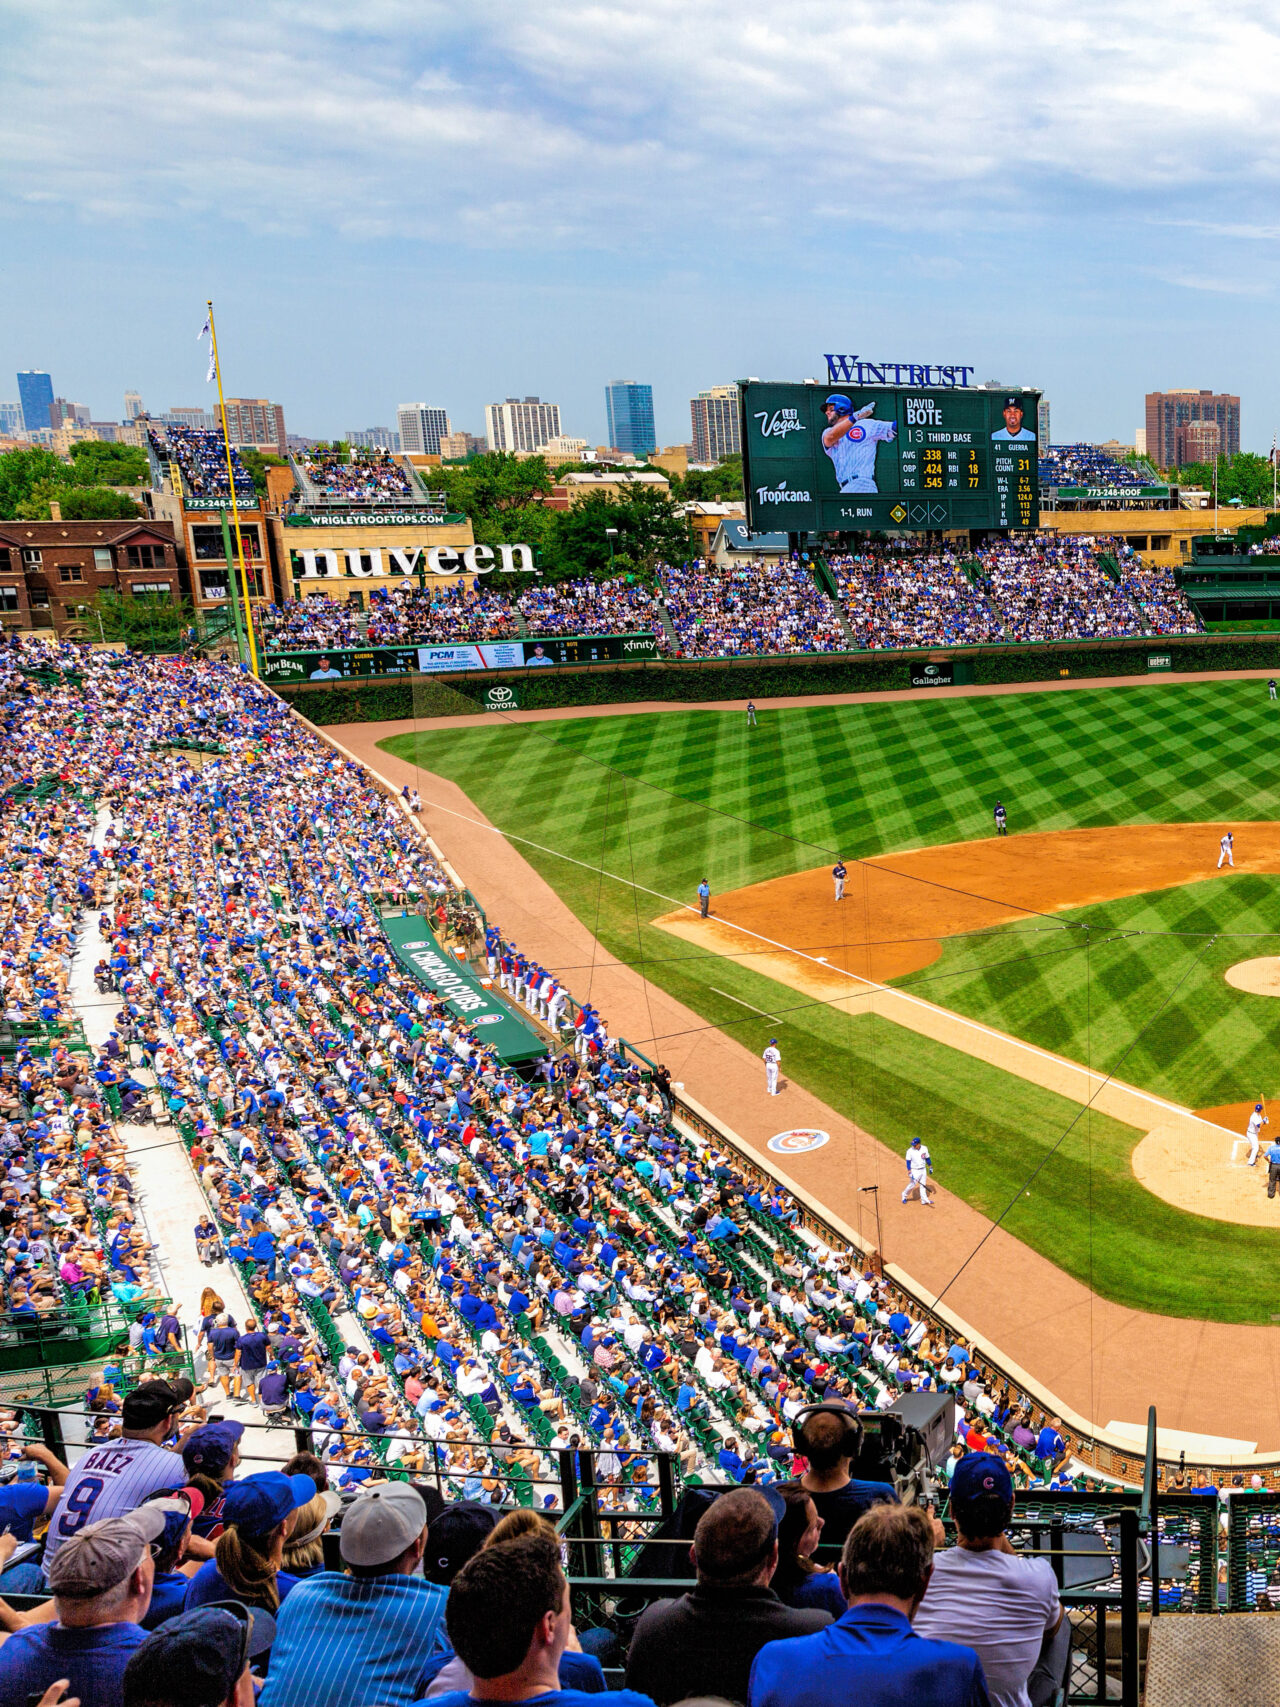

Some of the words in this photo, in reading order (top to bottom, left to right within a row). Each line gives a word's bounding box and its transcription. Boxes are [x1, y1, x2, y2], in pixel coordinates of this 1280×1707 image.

[823, 354, 974, 388] WINTRUST
[906, 398, 935, 409] DAVID
[782, 409, 798, 419] LAS
[907, 409, 943, 425] BOTE
[753, 410, 807, 439] Vegas
[908, 429, 924, 443] 13
[927, 433, 951, 443] THIRD
[953, 433, 972, 443] BASE
[902, 451, 916, 460] AVG
[923, 450, 942, 461] .338
[947, 451, 957, 460] HR
[969, 450, 976, 460] 3
[902, 464, 917, 473] OBP
[923, 463, 942, 475] .424
[967, 463, 979, 474] 18
[995, 464, 1014, 472] COUNT
[1018, 459, 1030, 471] 31
[903, 478, 916, 487] SLG
[924, 477, 943, 488] .545
[948, 479, 958, 487] AB
[968, 477, 979, 488] 77
[997, 485, 1009, 493] ERA
[1087, 488, 1142, 497] 773-248-ROOF
[1017, 493, 1033, 501] 124.0
[856, 508, 873, 517] RUN
[310, 514, 444, 525] WRIGLEYROOFTOPS.COM
[299, 542, 537, 578] nuveen
[210, 587, 223, 598] W
[623, 640, 656, 653] xfinity
[430, 650, 455, 660] PCM
[280, 658, 304, 673] BEAM
[912, 675, 952, 686] Gallagher
[485, 701, 518, 710] TOYOTA
[409, 951, 463, 986] CHICAGO
[83, 1452, 134, 1475] BAEZ
[983, 1476, 995, 1490] C
[58, 1476, 105, 1536] 9
[438, 1557, 449, 1568] C
